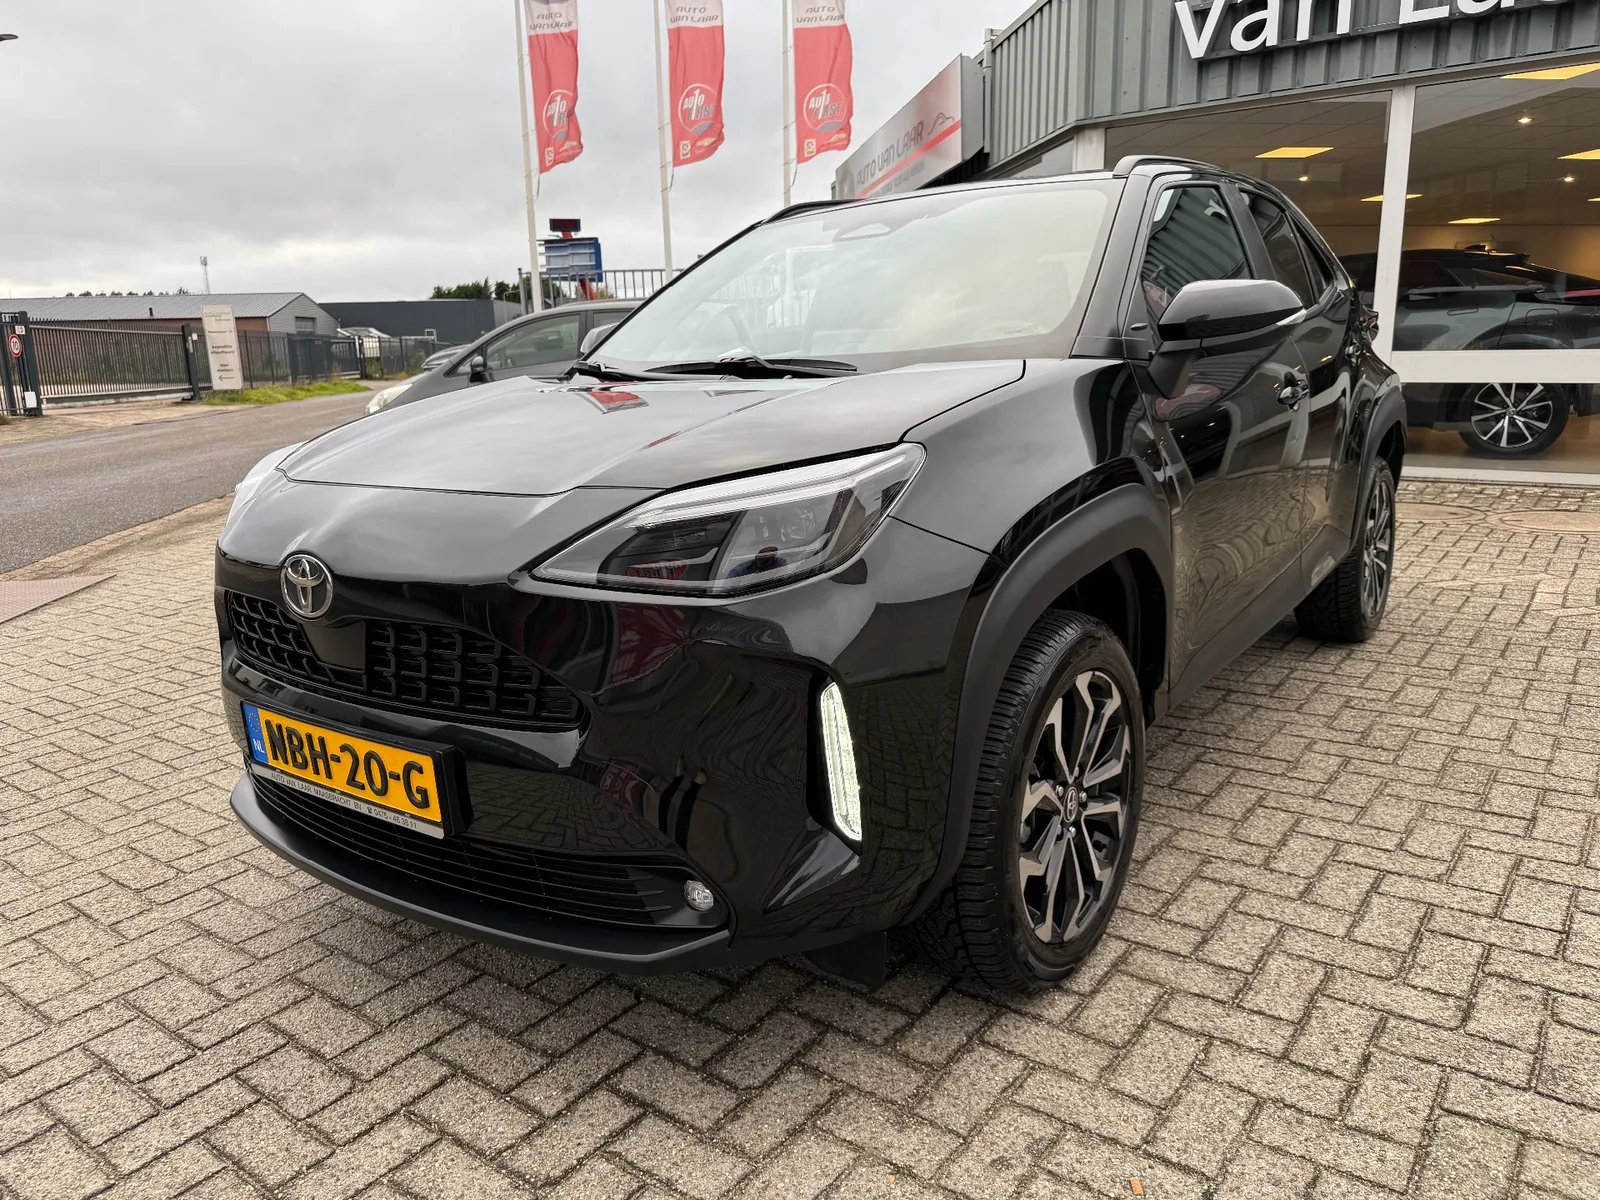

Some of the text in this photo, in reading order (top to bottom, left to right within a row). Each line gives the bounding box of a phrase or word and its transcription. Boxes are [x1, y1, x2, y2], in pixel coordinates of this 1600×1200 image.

[536, 12, 562, 20] AUTO
[805, 6, 836, 14] AUTO
[670, 14, 719, 23] VAN LAAR
[1174, 0, 1350, 60] van
[856, 158, 876, 189] AUTO
[877, 144, 895, 172] VAN
[896, 120, 924, 158] LAAR
[252, 738, 265, 753] NL
[264, 718, 430, 810] NBH-20-G
[271, 772, 285, 783] AUTO
